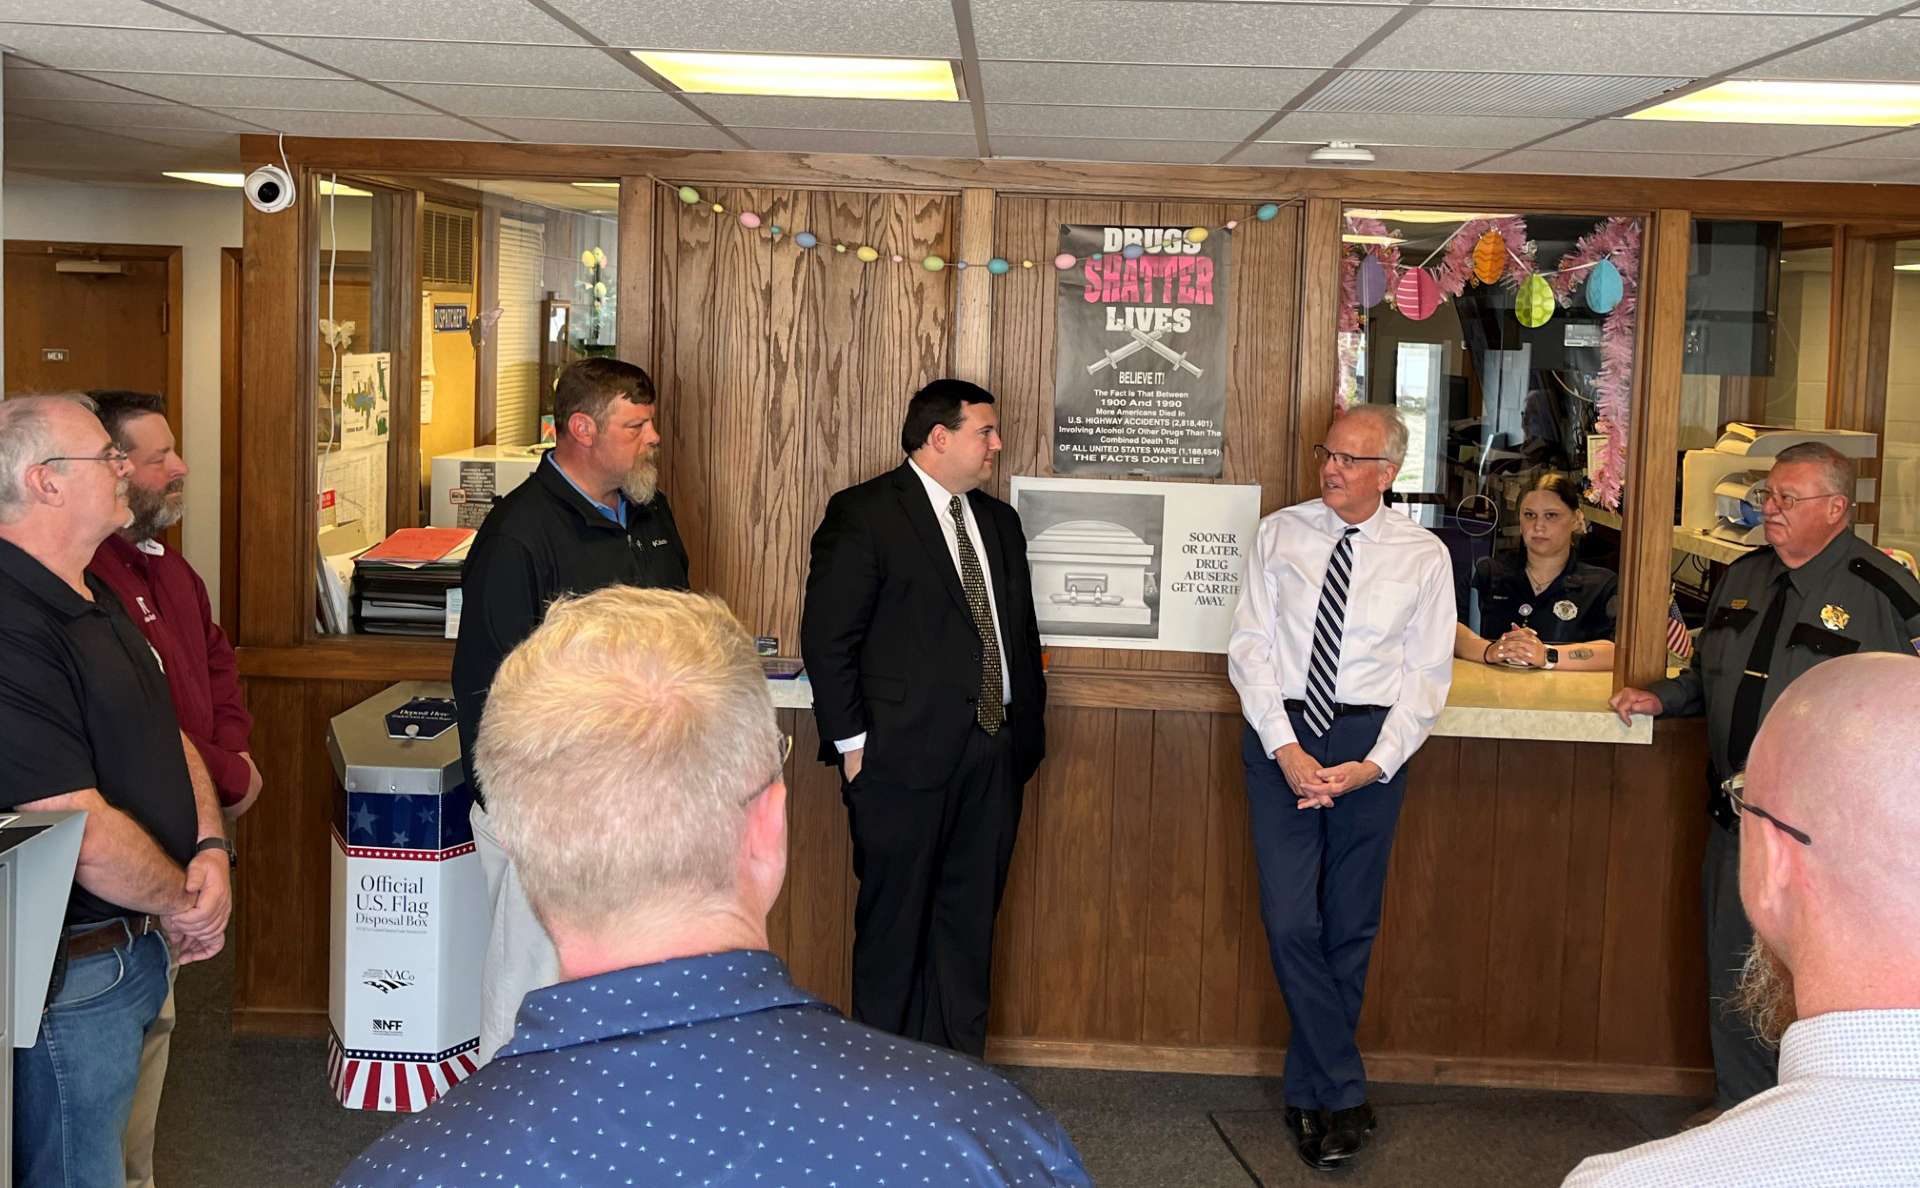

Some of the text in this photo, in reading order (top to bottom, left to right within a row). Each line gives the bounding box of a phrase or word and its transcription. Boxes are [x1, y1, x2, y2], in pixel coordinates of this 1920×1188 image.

[1103, 227, 1201, 255] DRUGS
[1084, 255, 1214, 305] SHATTER
[1105, 306, 1191, 333] LIVES
[1119, 371, 1165, 385] BELIEVE IT!
[1094, 389, 1108, 397] The
[1110, 389, 1126, 397] Fact
[1137, 390, 1154, 398] That
[1129, 399, 1152, 407] And
[1155, 400, 1182, 408] 1990
[1117, 408, 1157, 417] Americans
[1159, 409, 1176, 417] Died
[1085, 416, 1122, 425] HIGHWAY
[1124, 417, 1170, 426] ACCIDENTS
[1059, 426, 1221, 437] Involving Alcohol Or Other Drugs Than The
[1100, 436, 1139, 444] Combined
[1141, 436, 1163, 445] Death
[1059, 444, 1071, 452] OF
[1072, 444, 1087, 452] ALL
[1089, 445, 1119, 453] UNITED
[1121, 446, 1151, 454] STATES
[1153, 447, 1177, 455] WARS
[1101, 454, 1139, 463] FACTS
[1142, 456, 1179, 464] DON'T
[1189, 532, 1236, 543] SOONER
[1182, 544, 1198, 554] OR
[1196, 559, 1228, 570] DRUG
[1184, 571, 1239, 582] ABUSERS
[1171, 582, 1240, 595] GET CARRIE
[361, 875, 423, 894] Official
[357, 894, 429, 918] U.S. Flag
[354, 912, 428, 928] Disposal Box
